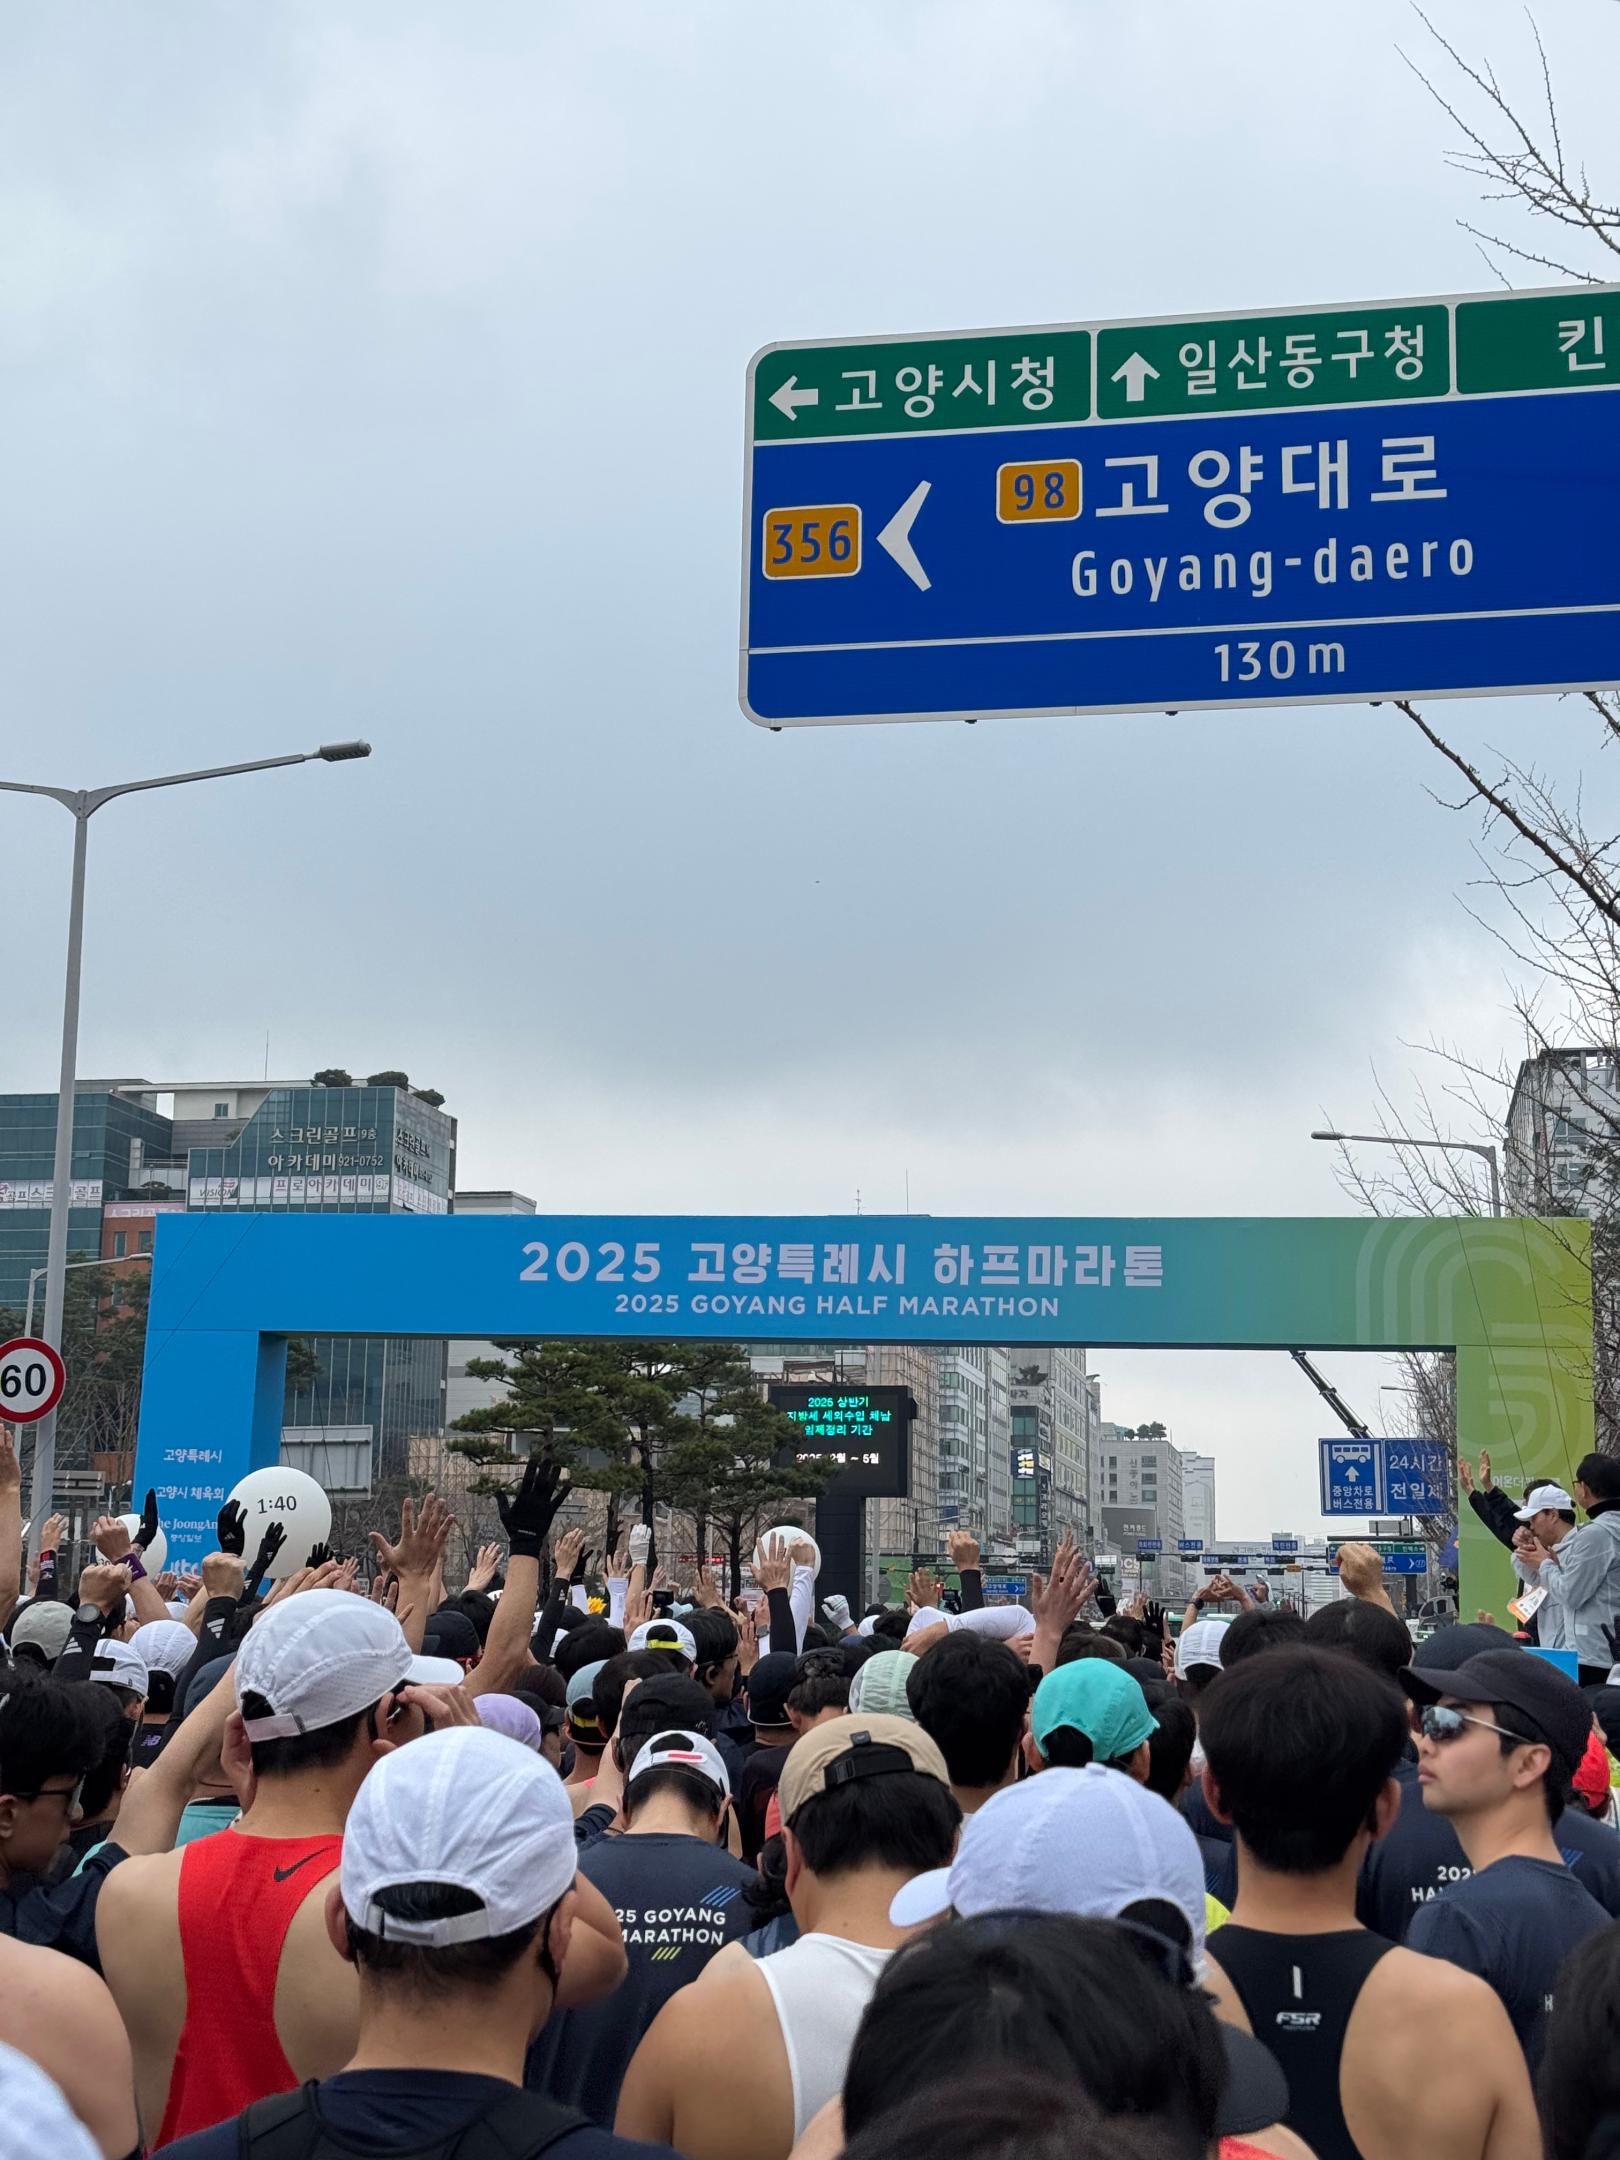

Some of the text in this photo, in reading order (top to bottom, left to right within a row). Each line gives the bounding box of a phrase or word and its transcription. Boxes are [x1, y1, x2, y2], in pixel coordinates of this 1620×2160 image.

[1559, 316, 1606, 372] 킨
[1178, 324, 1424, 395] 일산동구청
[835, 356, 1054, 418] 고양시청
[1095, 435, 1447, 528] 고양대로
[1013, 471, 1066, 511] 98
[772, 520, 852, 565] 356
[1071, 537, 1474, 602] Goyang-daero
[269, 1126, 358, 1145] 스크린골프
[267, 1153, 384, 1172] 아카데미 921-0752
[31, 1185, 101, 1200] 스크골프
[275, 1177, 372, 1193] 프로아카데미
[519, 1241, 1164, 1287] 2025 고양특례시 하프마라톤
[614, 1294, 1059, 1317] 2025 GOYANG HALF MARATHON
[1, 1363, 47, 1398] 60
[836, 1396, 869, 1408] 상반기
[822, 1410, 865, 1422] 세외수입
[869, 1410, 893, 1422] 체납
[850, 1425, 873, 1436] 기간
[163, 1449, 223, 1464] 고양특례시
[862, 1453, 880, 1464] 5월
[1389, 1454, 1443, 1472] 24시간
[156, 1486, 225, 1501] 고양시 체육회
[1332, 1485, 1374, 1498] 중앙차로
[257, 1495, 297, 1514] 1:40
[1332, 1498, 1374, 1510] 버스전용
[160, 1518, 217, 1531] he JoongAn
[1437, 1866, 1477, 1881] 202
[1411, 1886, 1443, 1902] HA
[614, 1907, 726, 1925] 25 GOYANG
